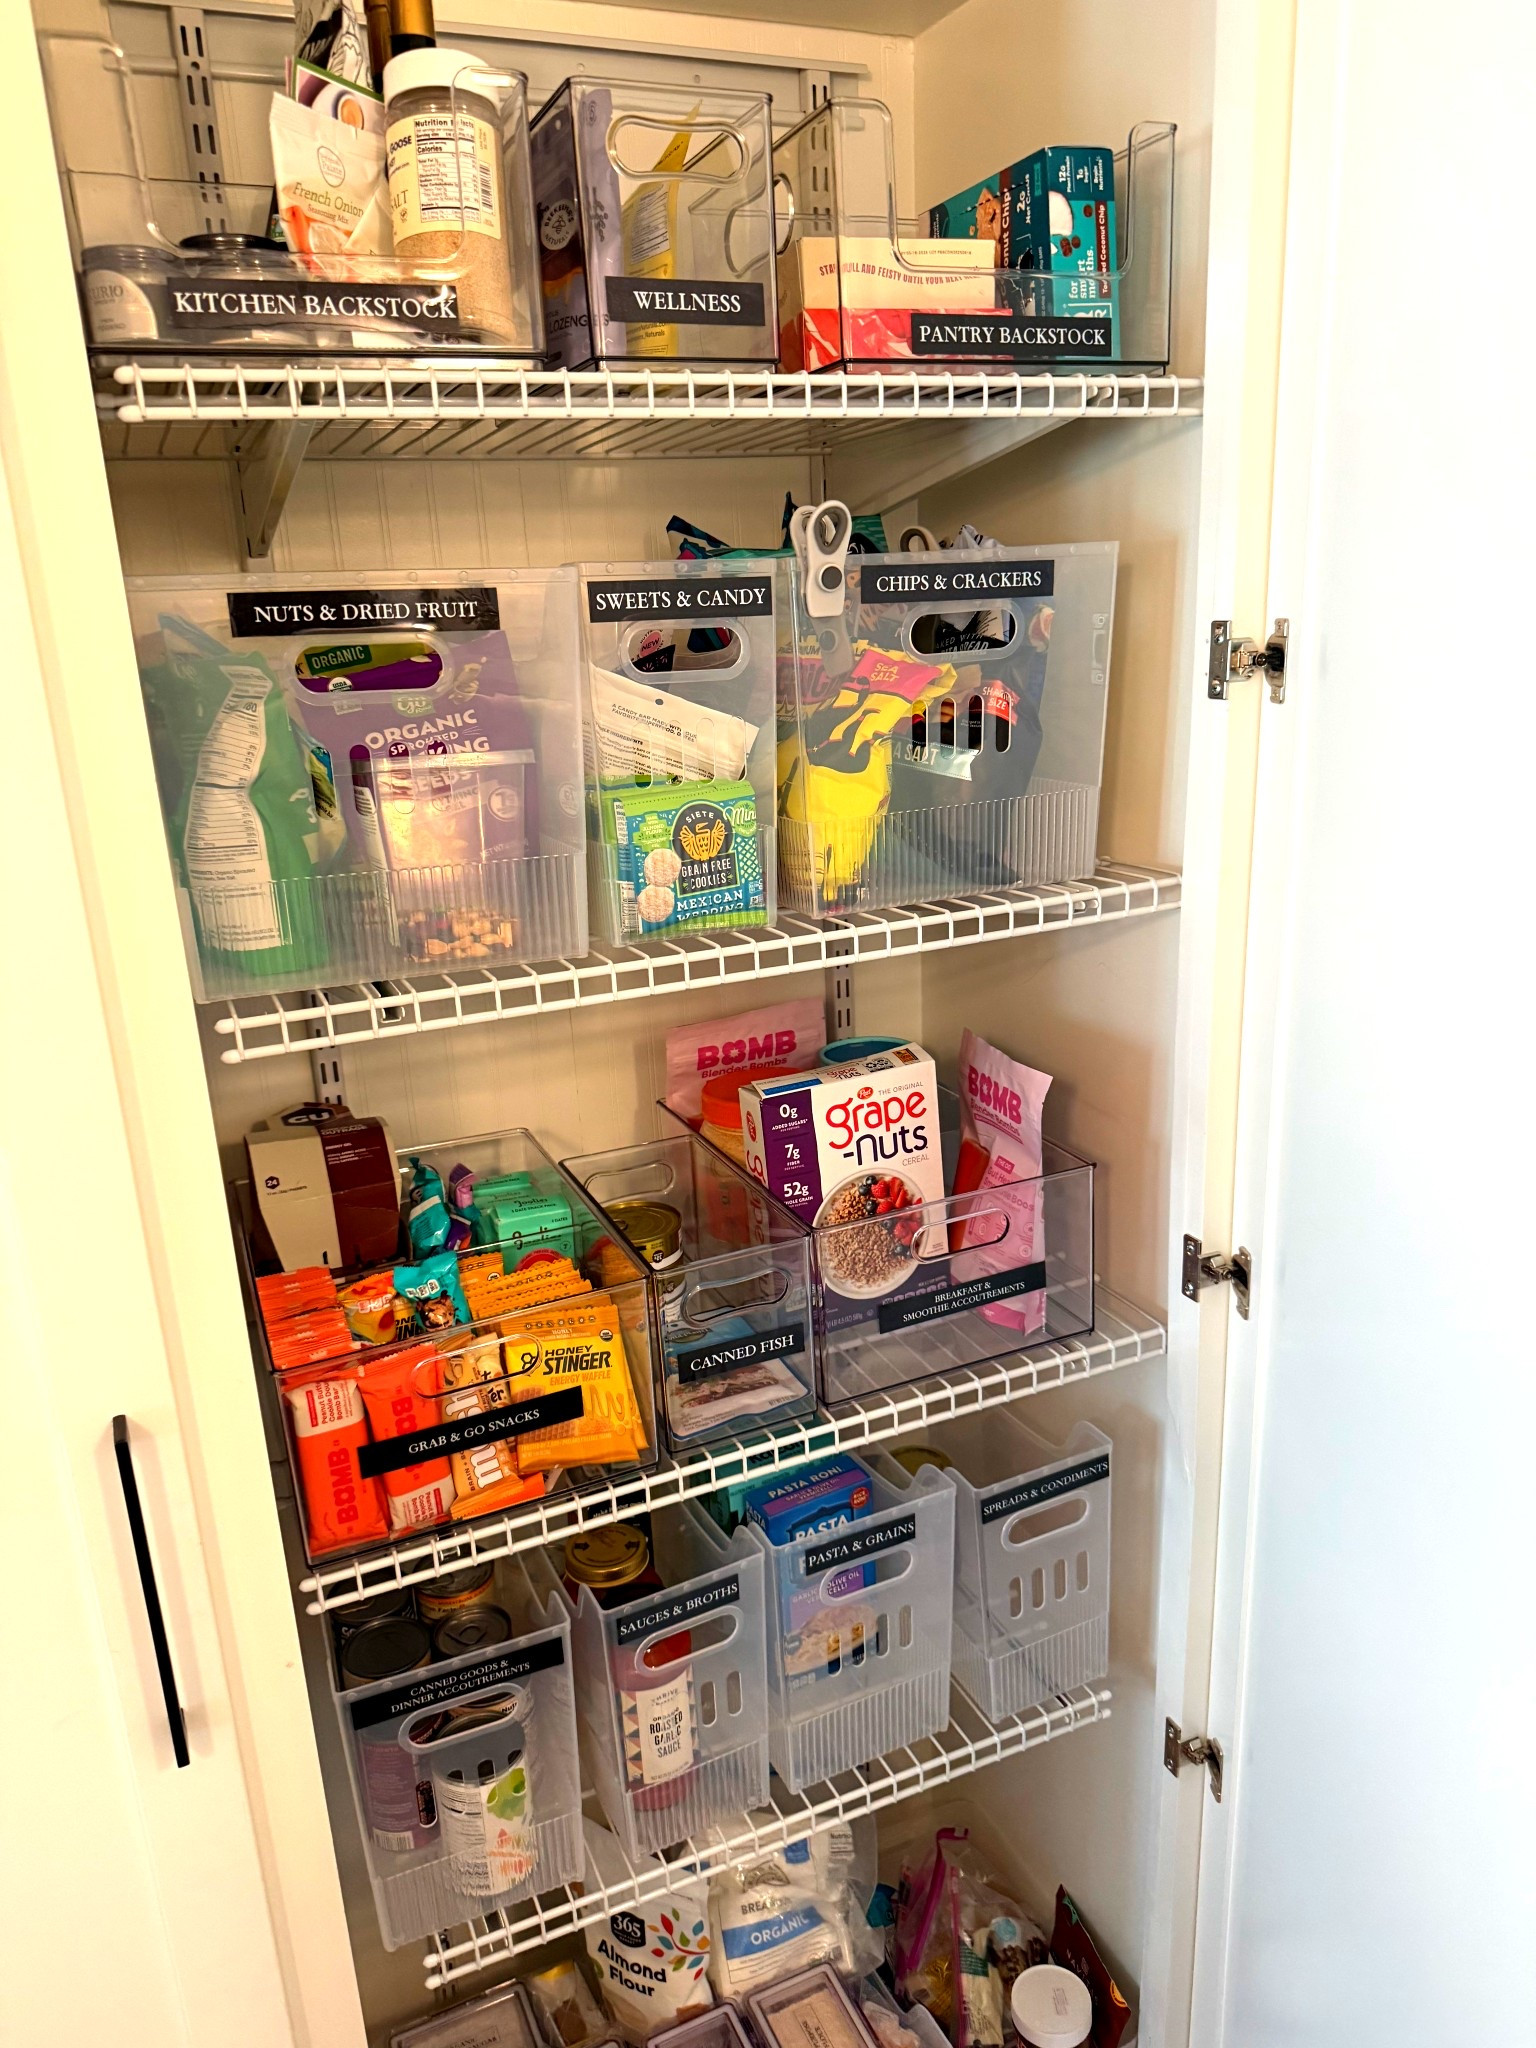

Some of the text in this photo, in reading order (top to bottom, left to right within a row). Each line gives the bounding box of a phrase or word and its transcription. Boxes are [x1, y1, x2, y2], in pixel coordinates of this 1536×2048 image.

[415, 119, 447, 128] Nutrition
[292, 181, 364, 218] French Onion
[1001, 192, 1012, 229] Chip
[307, 203, 349, 225] Seasoning Mix
[1098, 204, 1108, 261] Coconut Chip
[860, 264, 876, 276] AND
[877, 268, 902, 282] FEISTY
[902, 273, 924, 285] UNTIL
[925, 276, 944, 285] YOUR
[1068, 280, 1079, 299] for
[173, 291, 457, 319] KITCHEN BACKSTOCK
[632, 290, 742, 313] WELLNESS
[919, 325, 1106, 346] PANTRY BACKSTOCK
[876, 571, 1042, 593] CHIPS & CRACKERS
[596, 588, 767, 611] SWEETS & CANDY
[253, 601, 478, 623] NUTS & DRIED FRUIT
[640, 637, 661, 653] NEW
[311, 645, 366, 670] ORGANIC
[874, 662, 899, 675] SEA
[870, 671, 900, 683] SALT
[617, 704, 639, 717] CANDY
[988, 697, 1007, 710] SIZE
[364, 708, 478, 750] ORGANIC
[389, 730, 459, 756] SPROUTED
[904, 744, 939, 766] SALT
[685, 811, 715, 824] SIETE
[681, 858, 732, 878] GRAIN FREE
[689, 873, 728, 890] COOKIES
[676, 889, 744, 913] MEXICAN
[696, 1029, 797, 1072] BOMB
[701, 1055, 788, 1079] Blender Bombs
[857, 1087, 874, 1099] Post
[878, 1080, 924, 1096] THE ORIGINAL
[967, 1064, 1023, 1125] BOMB
[287, 1111, 331, 1124] GU
[779, 1103, 798, 1119] 0g
[825, 1090, 928, 1150] grape
[771, 1123, 789, 1131] ADDED
[784, 1143, 801, 1160] 7g
[901, 1153, 930, 1167] CEREAL
[266, 1179, 278, 1187] 24
[987, 1166, 999, 1181] Gut
[783, 1181, 810, 1198] 52g
[798, 1195, 814, 1204] GRAIN
[902, 1281, 1026, 1323] SMOOTHIE ACCOUTREMENTS
[934, 1281, 992, 1304] BREAKFAST &
[544, 1344, 594, 1357] HONEY
[690, 1334, 795, 1372] CANNED FISH
[542, 1350, 613, 1376] STINGER
[549, 1369, 611, 1387] ENERGY WAFFLE
[319, 1402, 329, 1425] Peanut
[326, 1400, 336, 1422] Cookie
[331, 1387, 343, 1420] Bomb Bar
[408, 1408, 541, 1455] GRAB & GO SNACKS
[327, 1447, 360, 1525] BOMB
[464, 1467, 476, 1492] BRAIN
[767, 1465, 843, 1500] PASTA RONI
[982, 1461, 1109, 1517] SPREADS & CONDIMENTS
[794, 1513, 850, 1544] PASTA
[807, 1521, 915, 1567] PASTA & GRAINS
[826, 1575, 848, 1589] OLIVE
[847, 1570, 860, 1581] OIL
[619, 1582, 739, 1636] SAUCES & BROTHS
[390, 1661, 531, 1713] DINNER ACCOUTREMENTS
[409, 1659, 509, 1696] CANNED GOODS &
[649, 1710, 683, 1735] ROASTED
[657, 1739, 682, 1759] SAUCE
[740, 1900, 773, 1916] BREA
[613, 1914, 641, 1939] 365
[750, 1913, 809, 1946] ORGANIC
[597, 1938, 667, 1983] Almond
[609, 1964, 655, 1997] Flour
